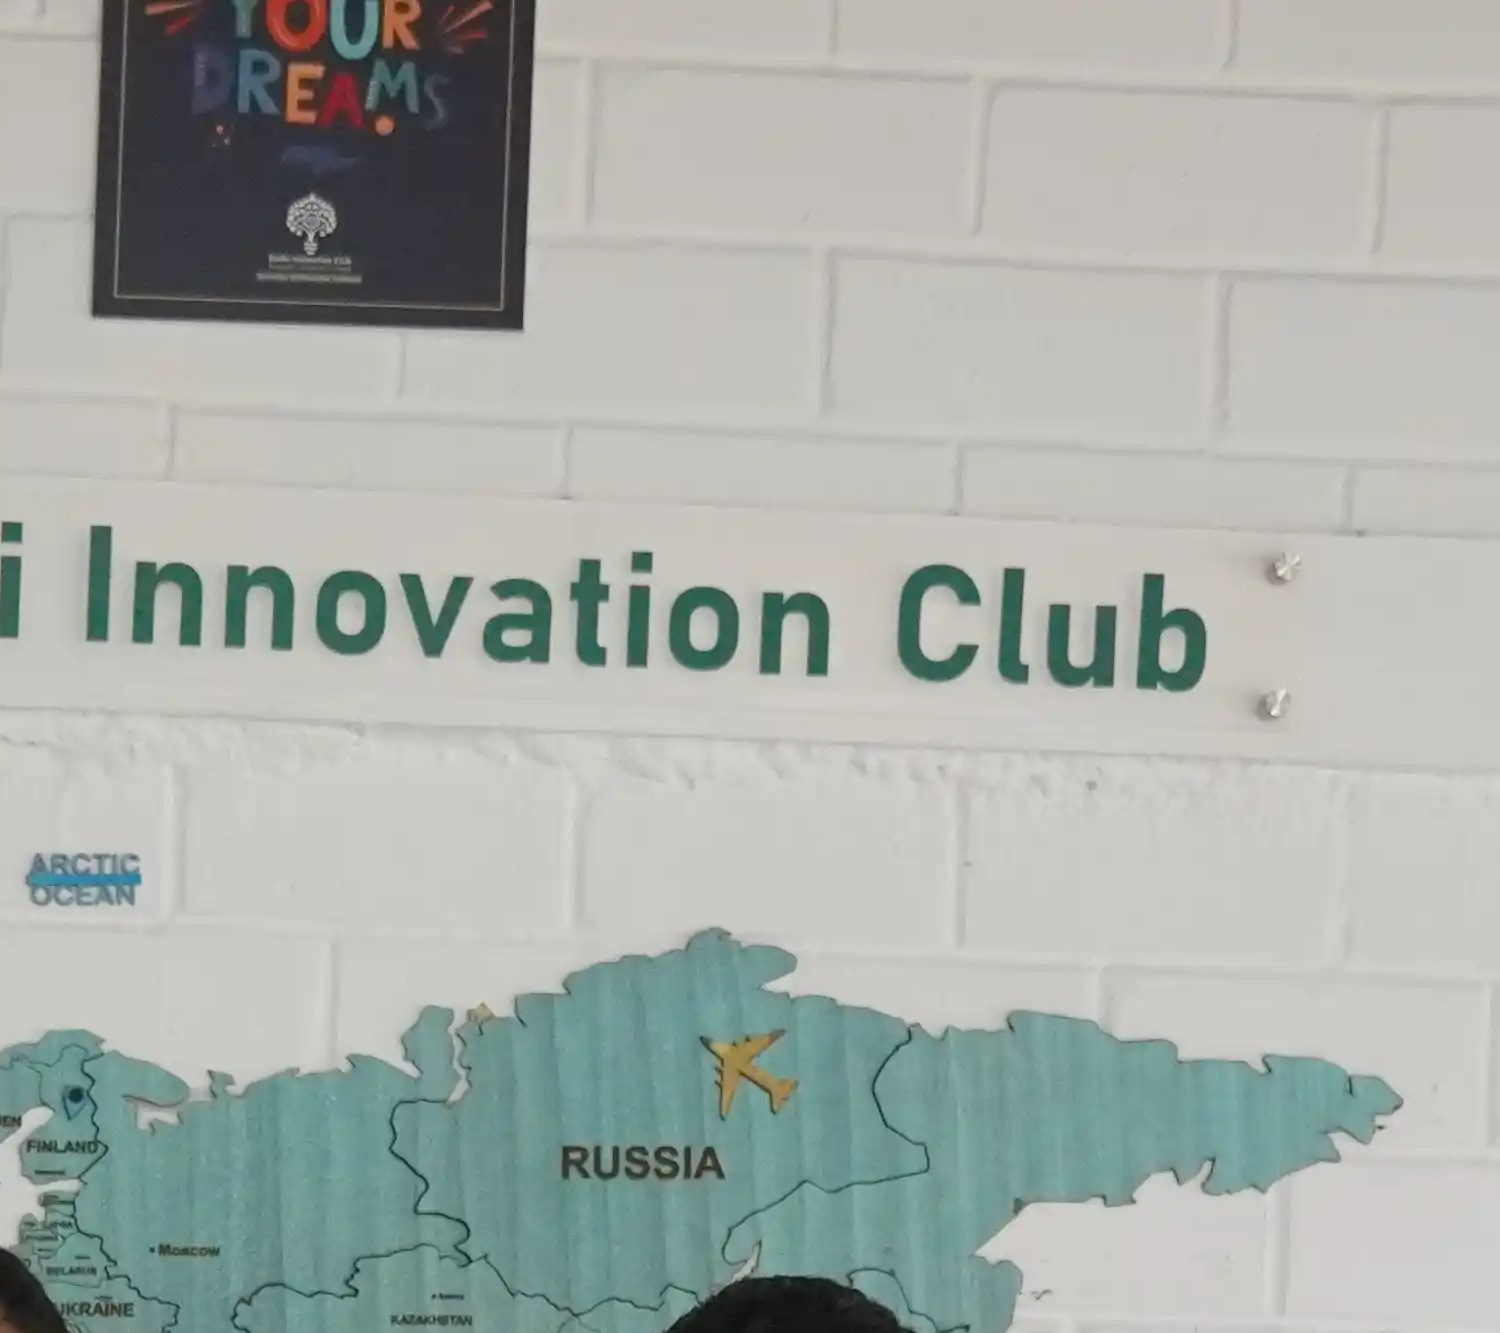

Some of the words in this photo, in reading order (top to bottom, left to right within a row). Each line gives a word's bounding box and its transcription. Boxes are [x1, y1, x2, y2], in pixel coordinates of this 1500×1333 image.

[191, 43, 450, 131] DREAMS
[86, 524, 830, 678] Innovation
[897, 563, 1209, 694] Club
[30, 853, 141, 878] ARCTIC
[29, 884, 136, 906] OCEAN
[26, 1140, 98, 1154] FINLAND
[561, 1145, 726, 1181] RUSSIA
[158, 1243, 221, 1257] Moscow
[390, 1314, 473, 1328] KAZAKHSTAN
